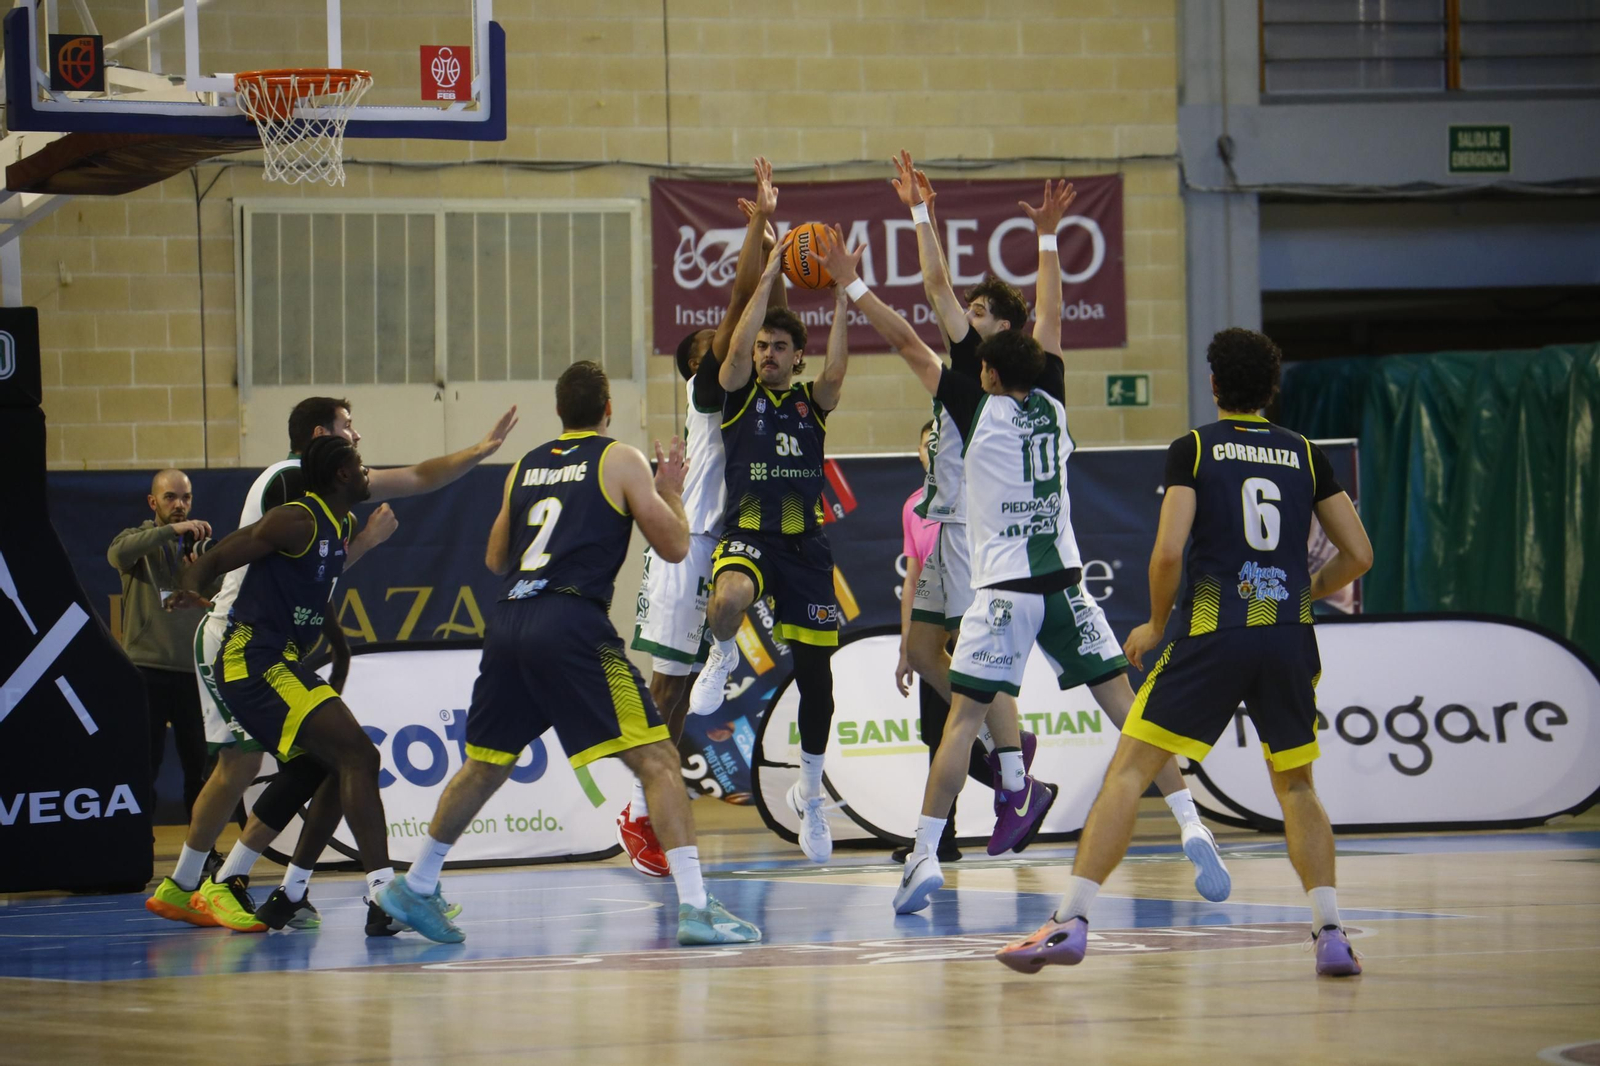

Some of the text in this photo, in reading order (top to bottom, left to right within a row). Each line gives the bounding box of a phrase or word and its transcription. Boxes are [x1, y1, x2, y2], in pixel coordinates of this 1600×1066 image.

[437, 92, 456, 100] FEB
[797, 231, 811, 277] Wilson
[775, 432, 803, 457] 30
[1019, 432, 1057, 482] 10
[1212, 441, 1300, 469] CORRALIZA
[1001, 501, 1044, 514] PIEDRA
[1240, 477, 1282, 551] 6
[519, 496, 563, 572] 2
[972, 650, 1014, 667] efficold
[837, 719, 910, 745] SAN
[504, 809, 563, 833] todo.
